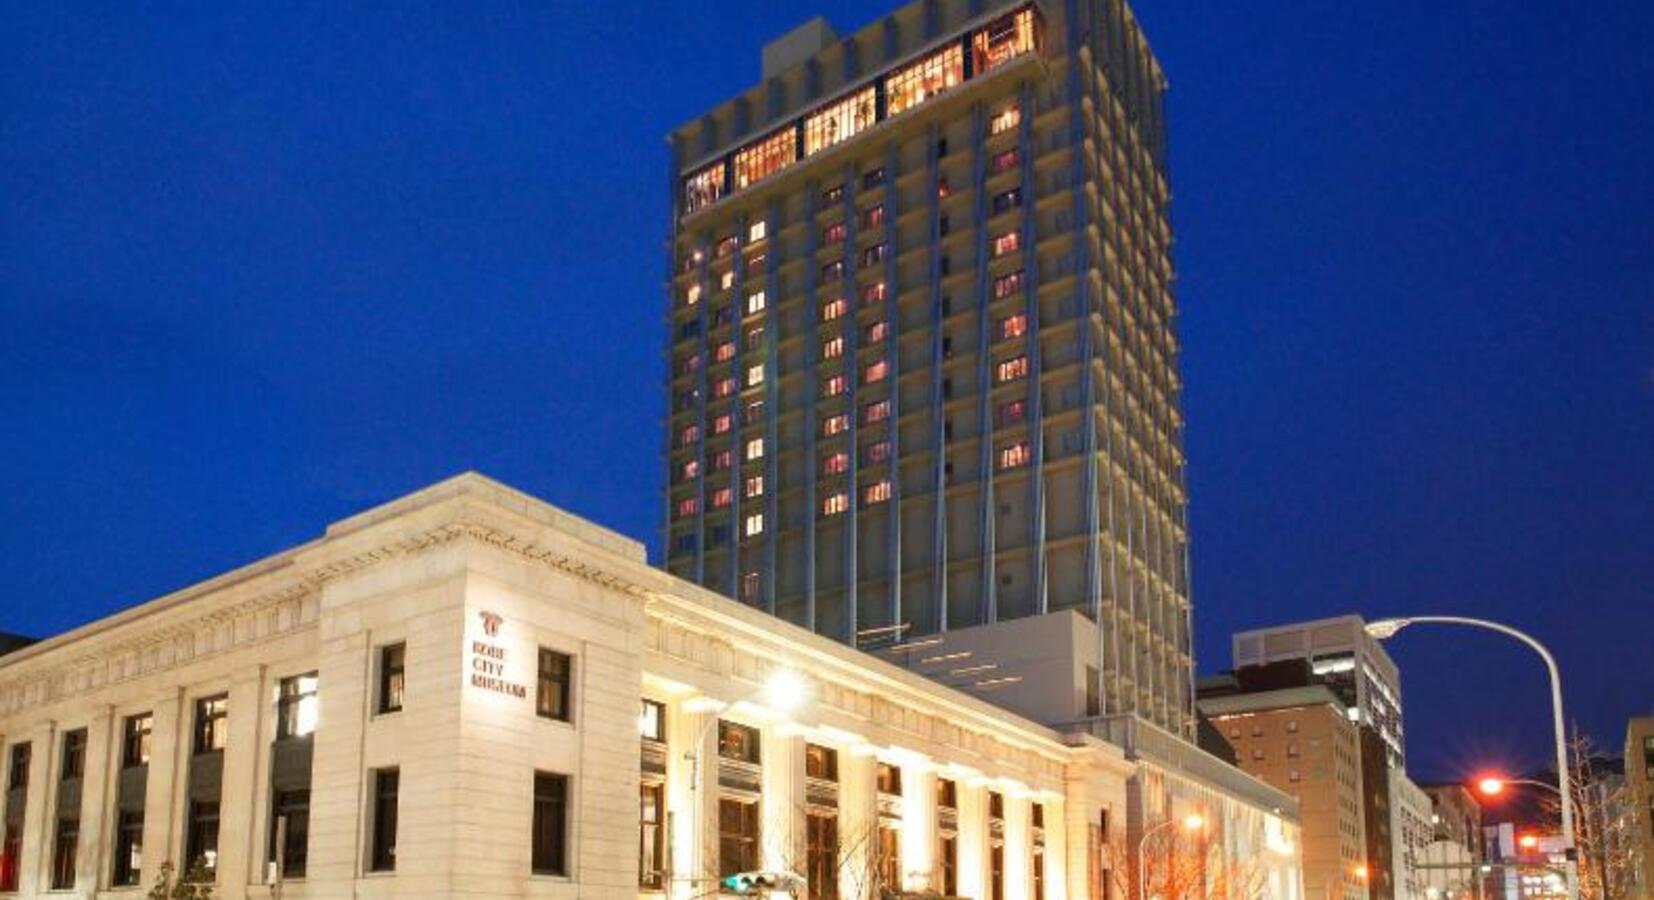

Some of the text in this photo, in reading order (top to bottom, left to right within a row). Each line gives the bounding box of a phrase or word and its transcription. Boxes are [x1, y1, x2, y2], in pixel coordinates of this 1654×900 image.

[473, 641, 504, 660] KOBE
[473, 657, 504, 677] CITY
[471, 674, 526, 698] MUSEUM
